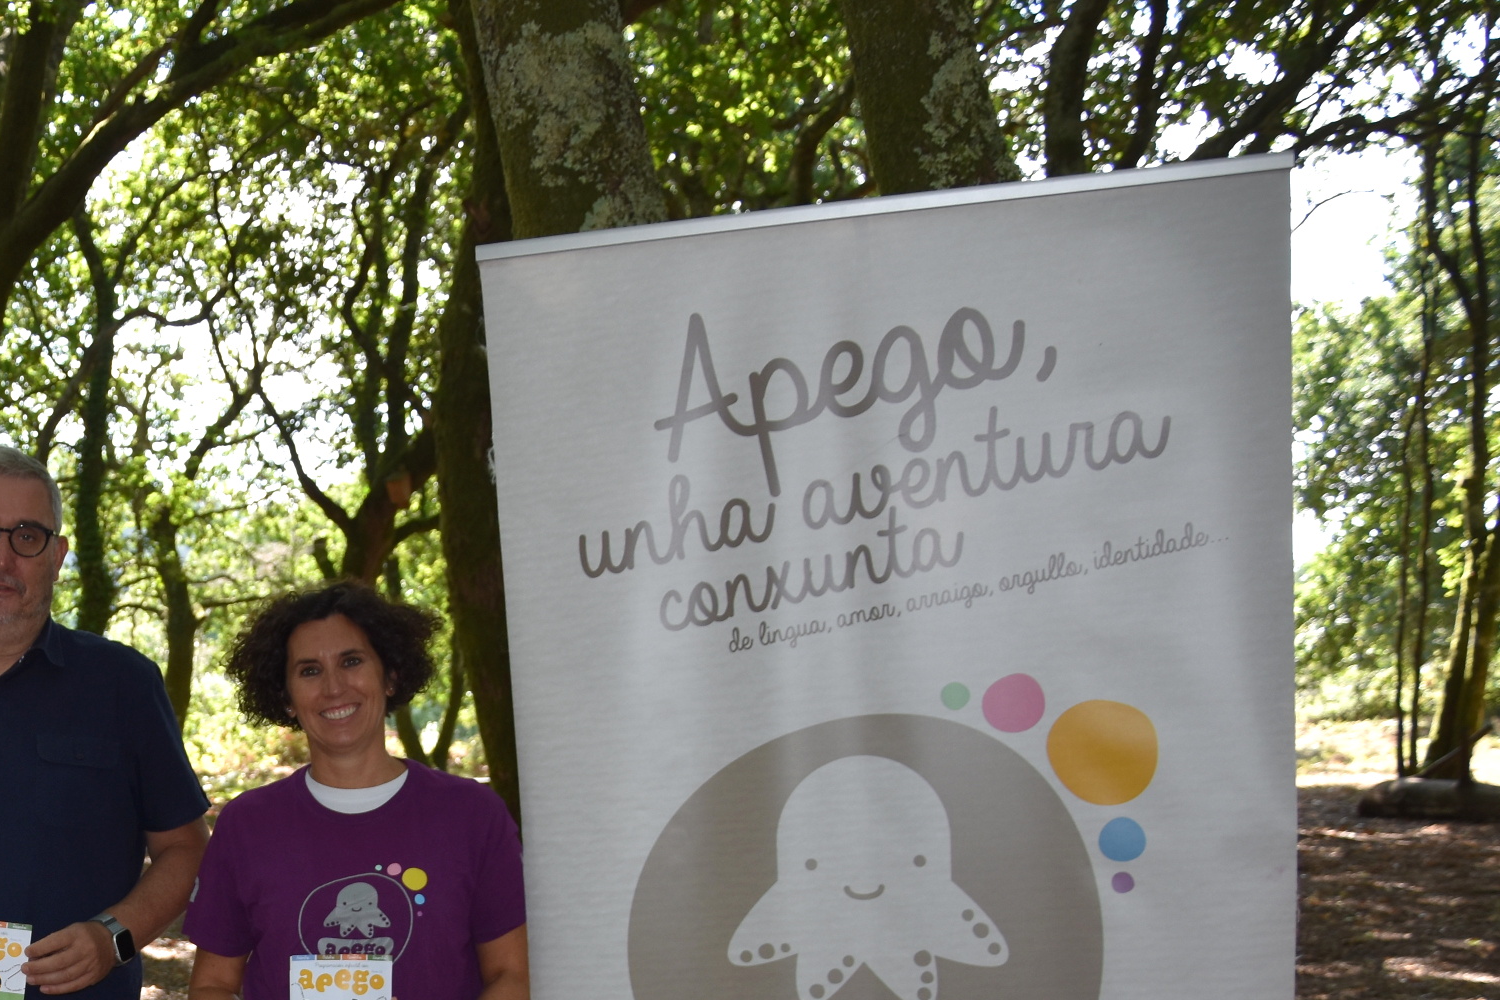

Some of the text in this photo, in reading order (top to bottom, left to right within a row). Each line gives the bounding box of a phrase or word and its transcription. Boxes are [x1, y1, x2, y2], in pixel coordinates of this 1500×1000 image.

[654, 308, 1057, 496] Apego,
[579, 406, 1172, 578] unha aventura
[660, 505, 964, 631] conxunta
[728, 627, 754, 653] de
[758, 621, 833, 649] lingua,
[836, 602, 901, 628] amor,
[906, 582, 994, 611] arraigo,
[999, 552, 1089, 595] orgullo,
[298, 969, 384, 996] apego
